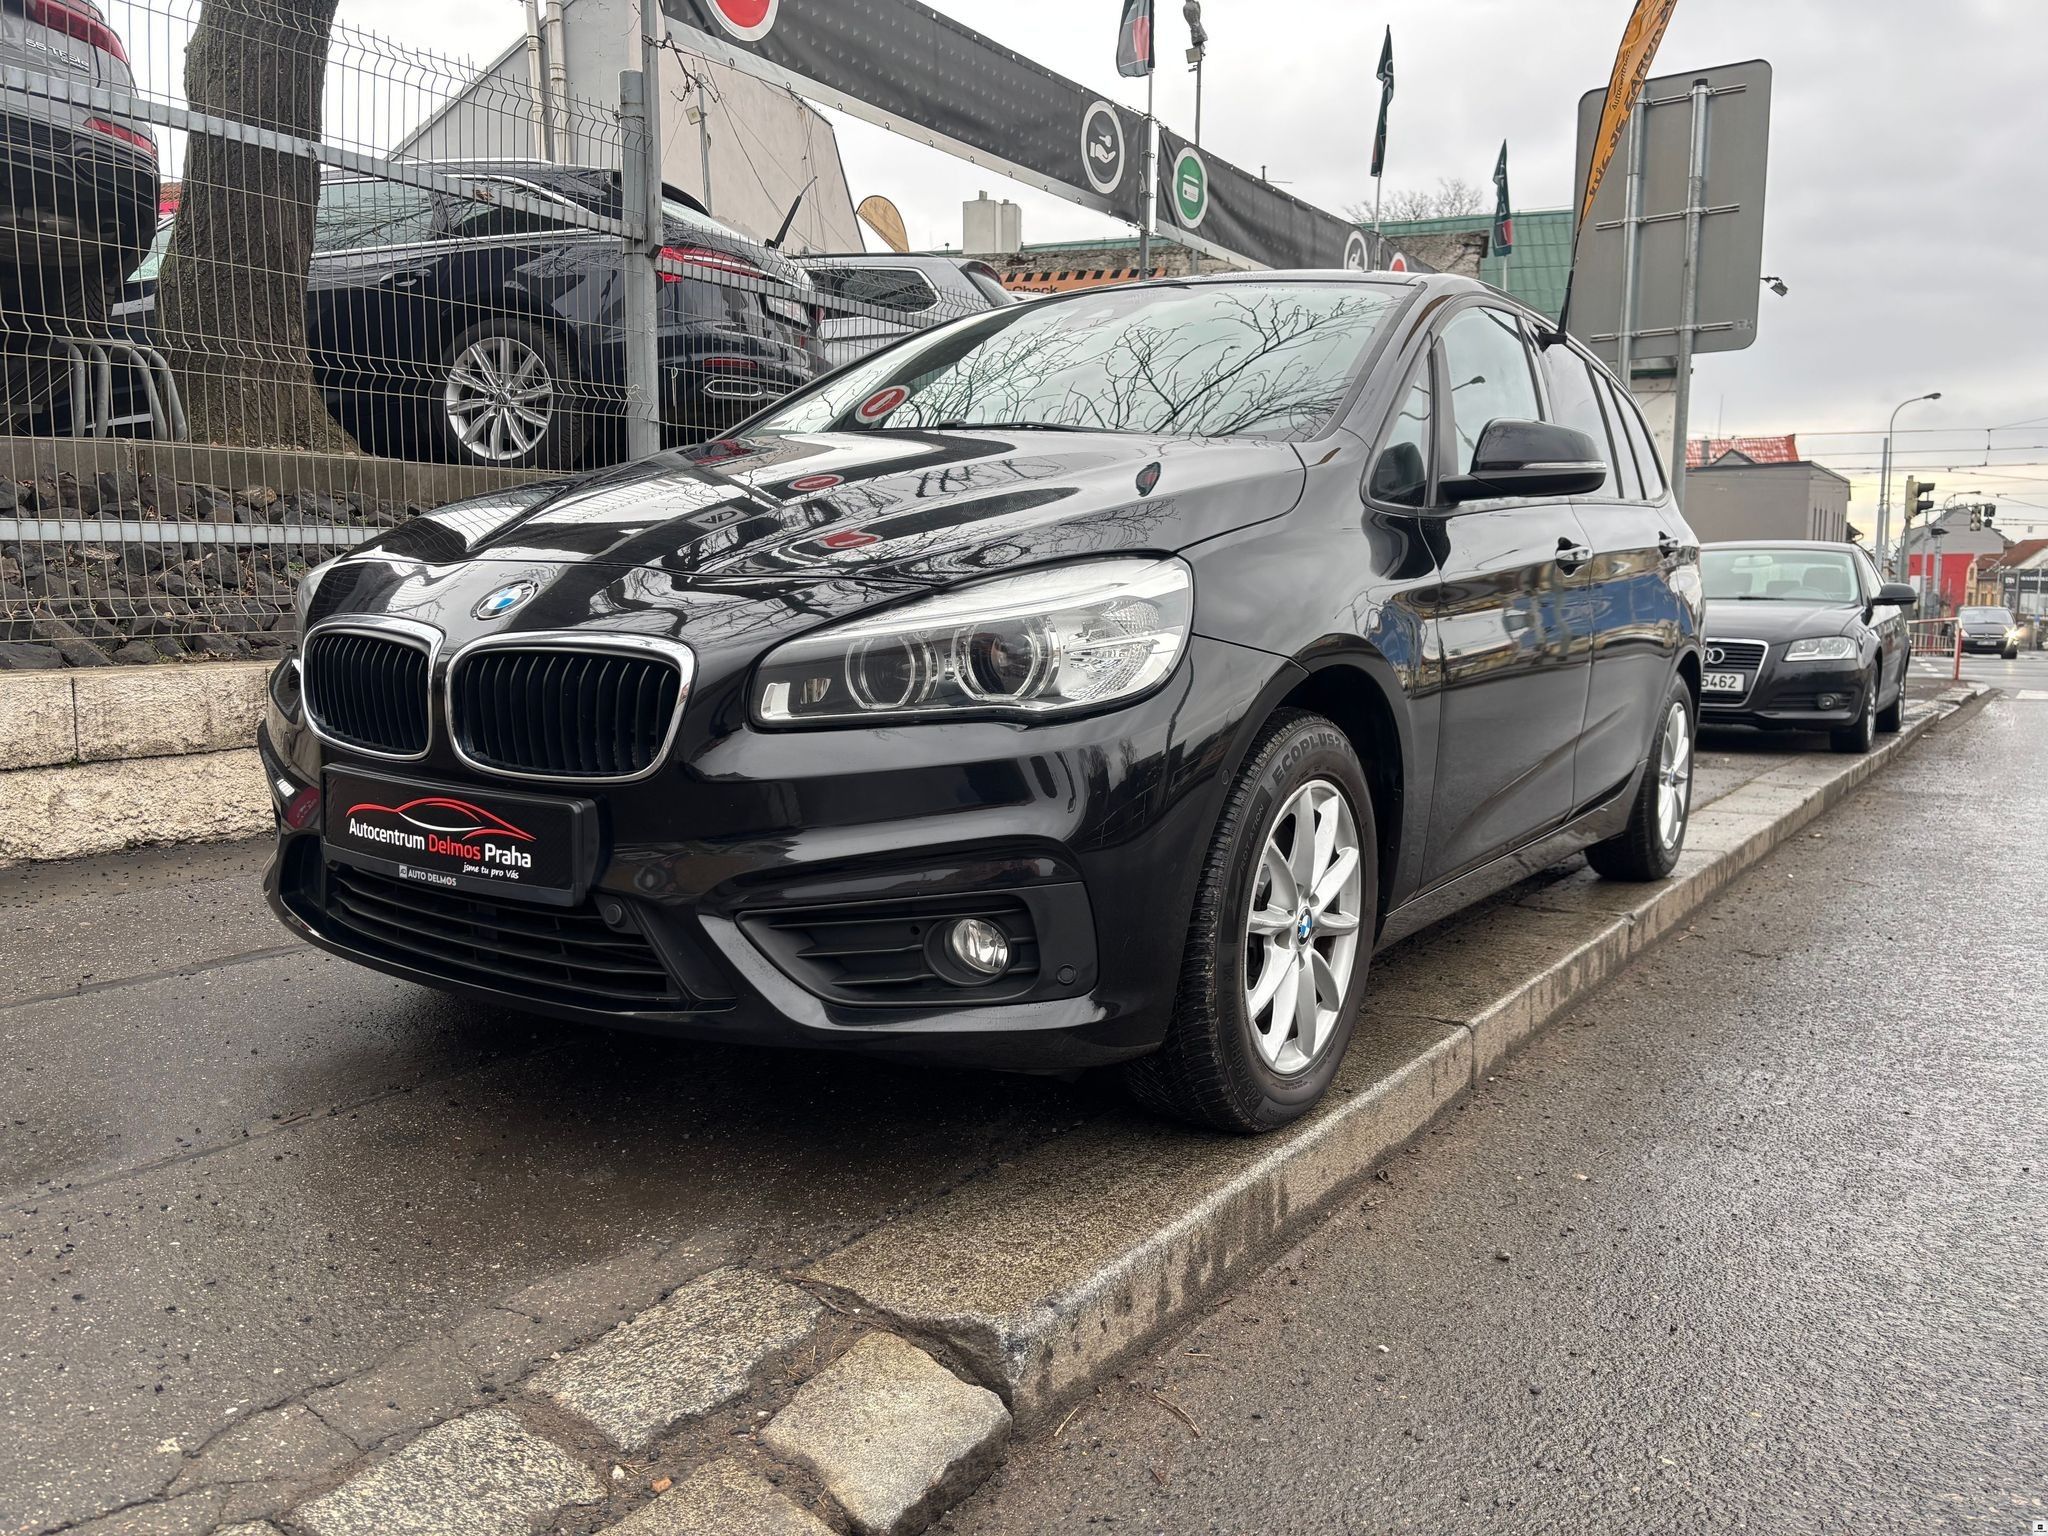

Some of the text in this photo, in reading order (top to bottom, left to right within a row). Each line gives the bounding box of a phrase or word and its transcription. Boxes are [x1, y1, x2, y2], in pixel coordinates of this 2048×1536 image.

[1702, 675, 1737, 689] 5462
[349, 818, 532, 868] Autocentrum Delmos Praha
[408, 869, 427, 881] AUTO
[427, 872, 457, 886] DELMOS
[462, 862, 520, 880] jsme tu pro Vás
